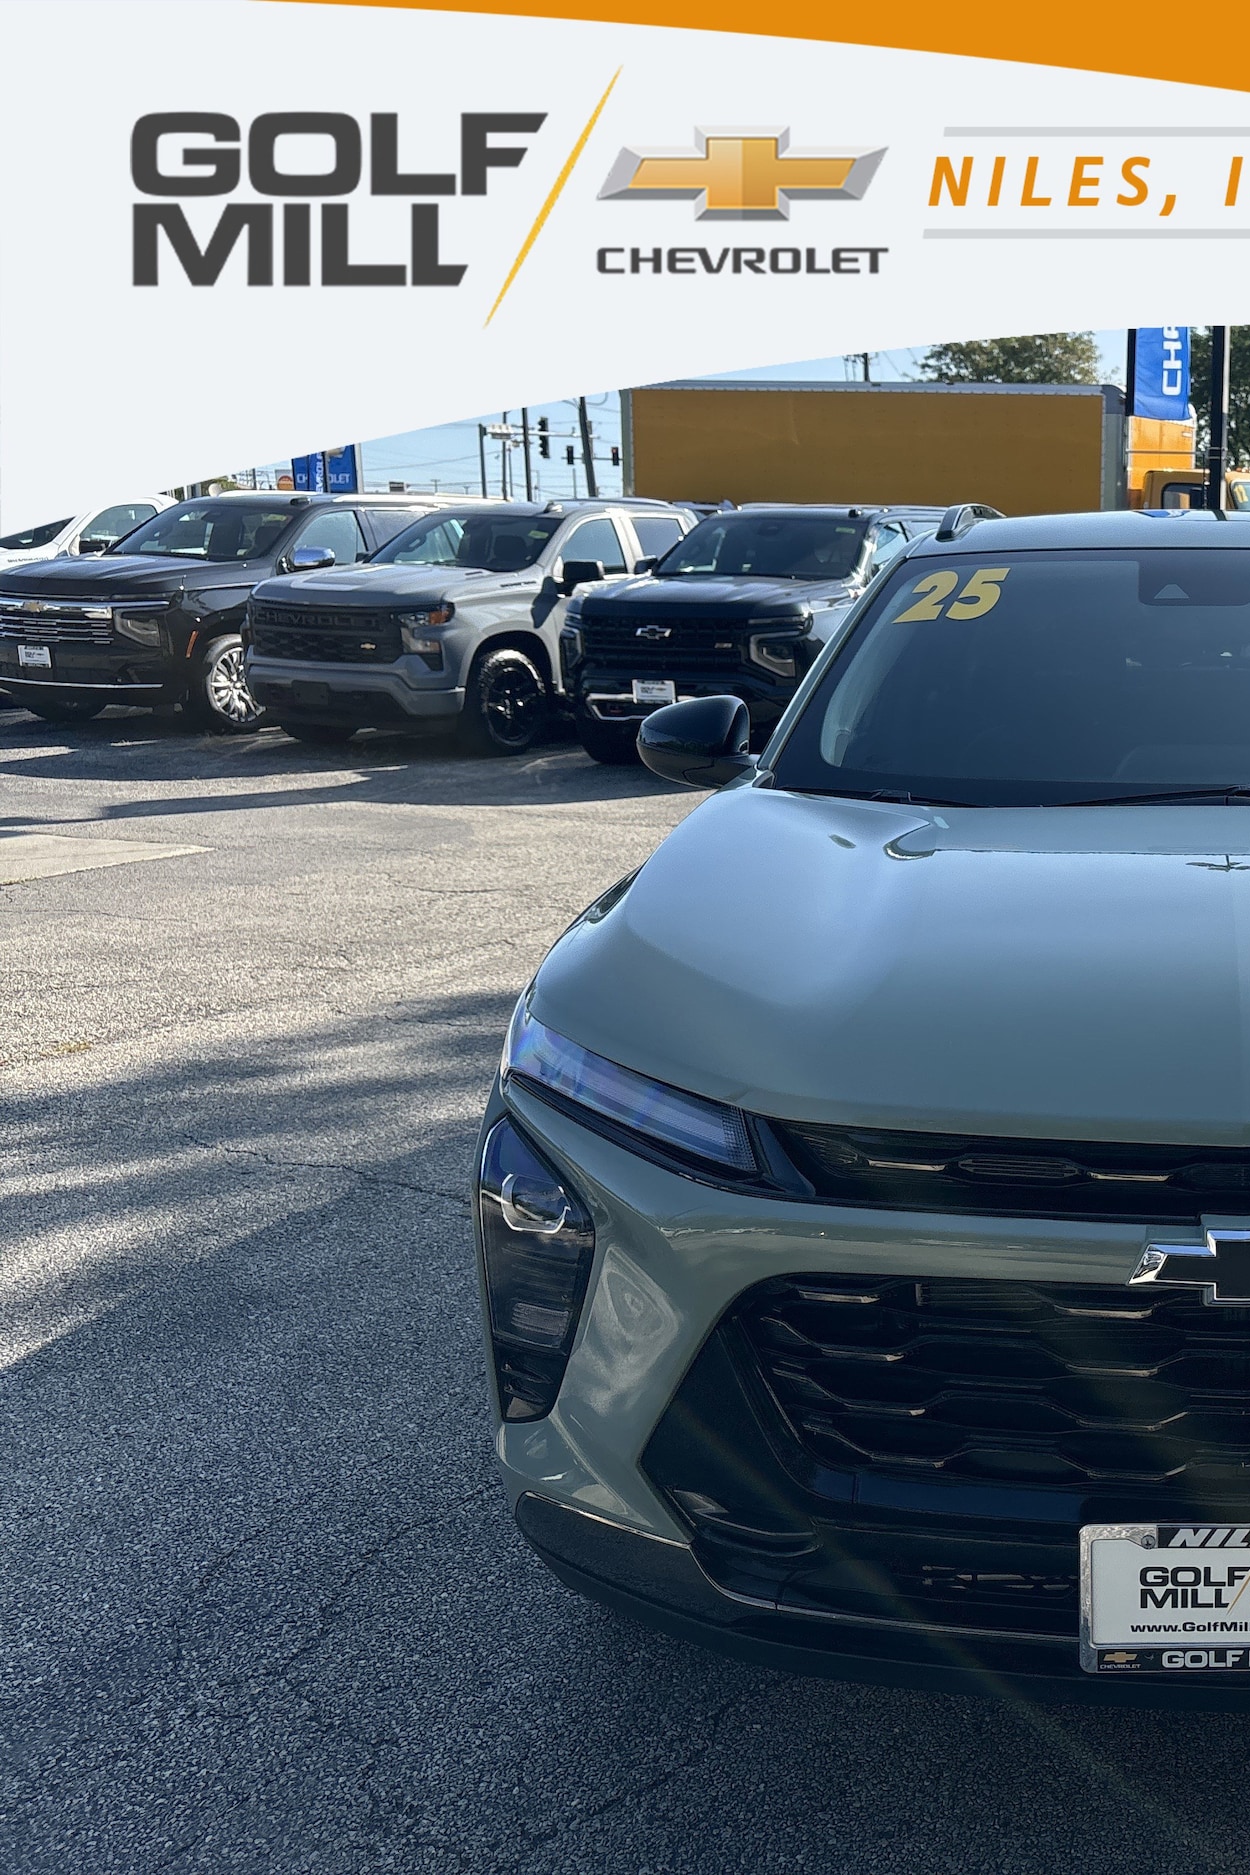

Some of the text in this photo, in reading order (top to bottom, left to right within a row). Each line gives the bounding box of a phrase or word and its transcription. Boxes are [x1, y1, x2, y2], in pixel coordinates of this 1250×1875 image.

[892, 567, 1011, 625] 25
[1140, 1588, 1233, 1609] MILL
[1161, 1650, 1244, 1668] GOLF
